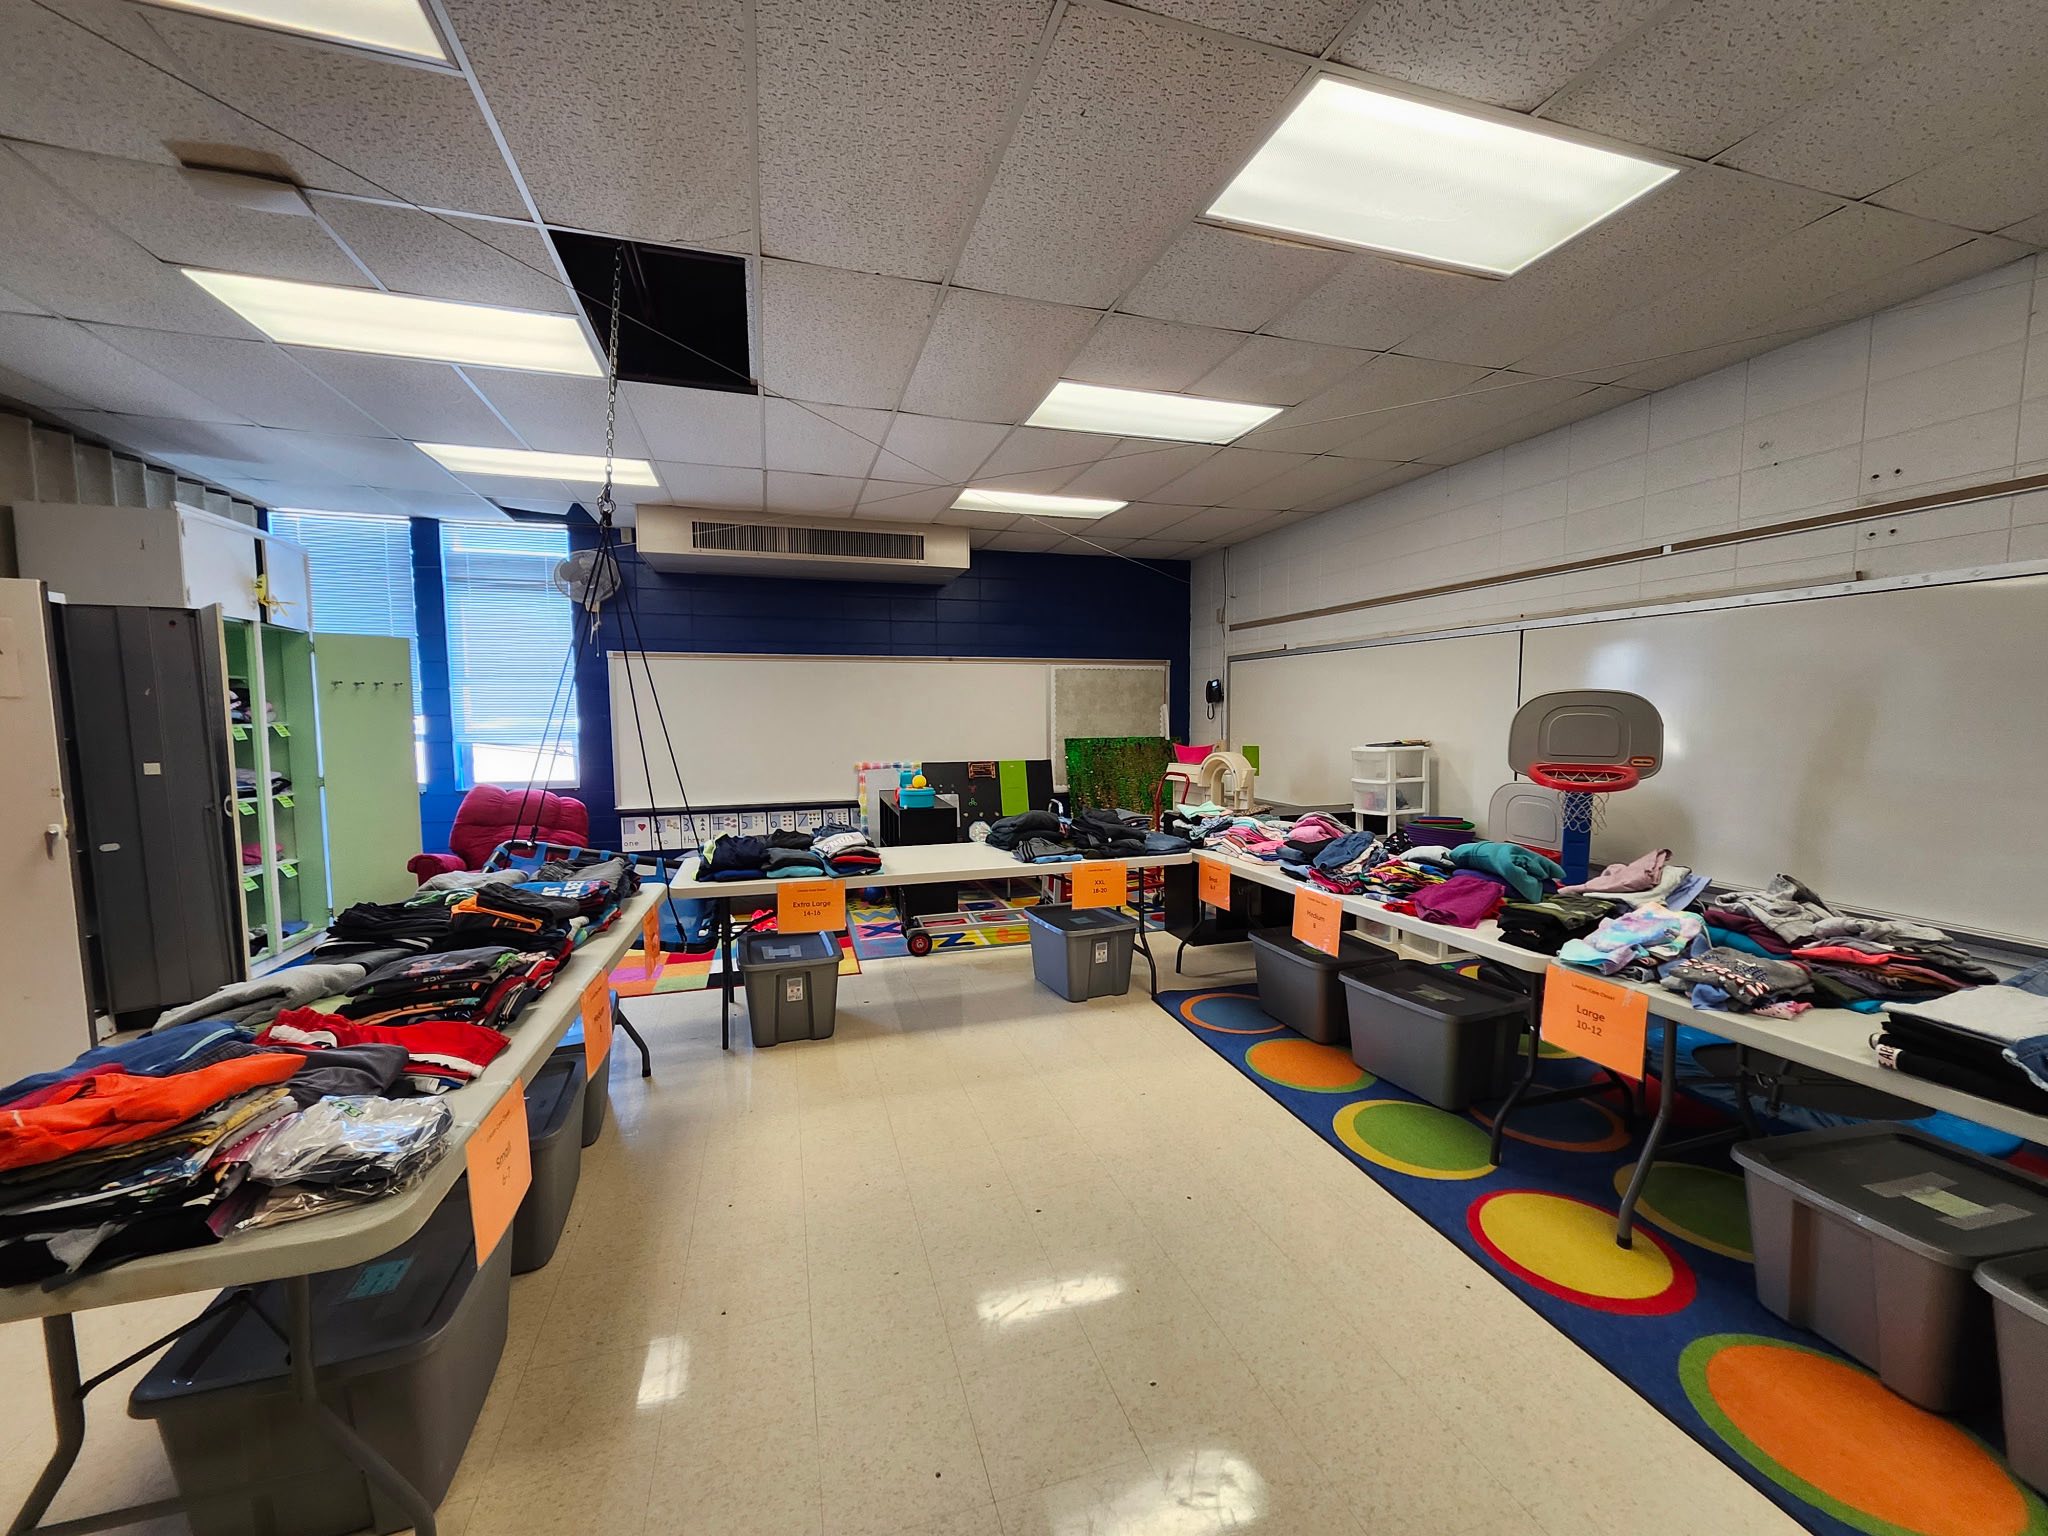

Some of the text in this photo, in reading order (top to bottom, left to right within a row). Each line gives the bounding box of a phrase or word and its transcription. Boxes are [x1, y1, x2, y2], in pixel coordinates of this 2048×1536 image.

[683, 817, 690, 832] 3
[712, 816, 724, 830] 4
[741, 815, 749, 829] 5
[769, 813, 778, 828] 6
[797, 812, 808, 827] 7
[1576, 1004, 1606, 1022] Large
[1576, 1020, 1603, 1037] 10-12
